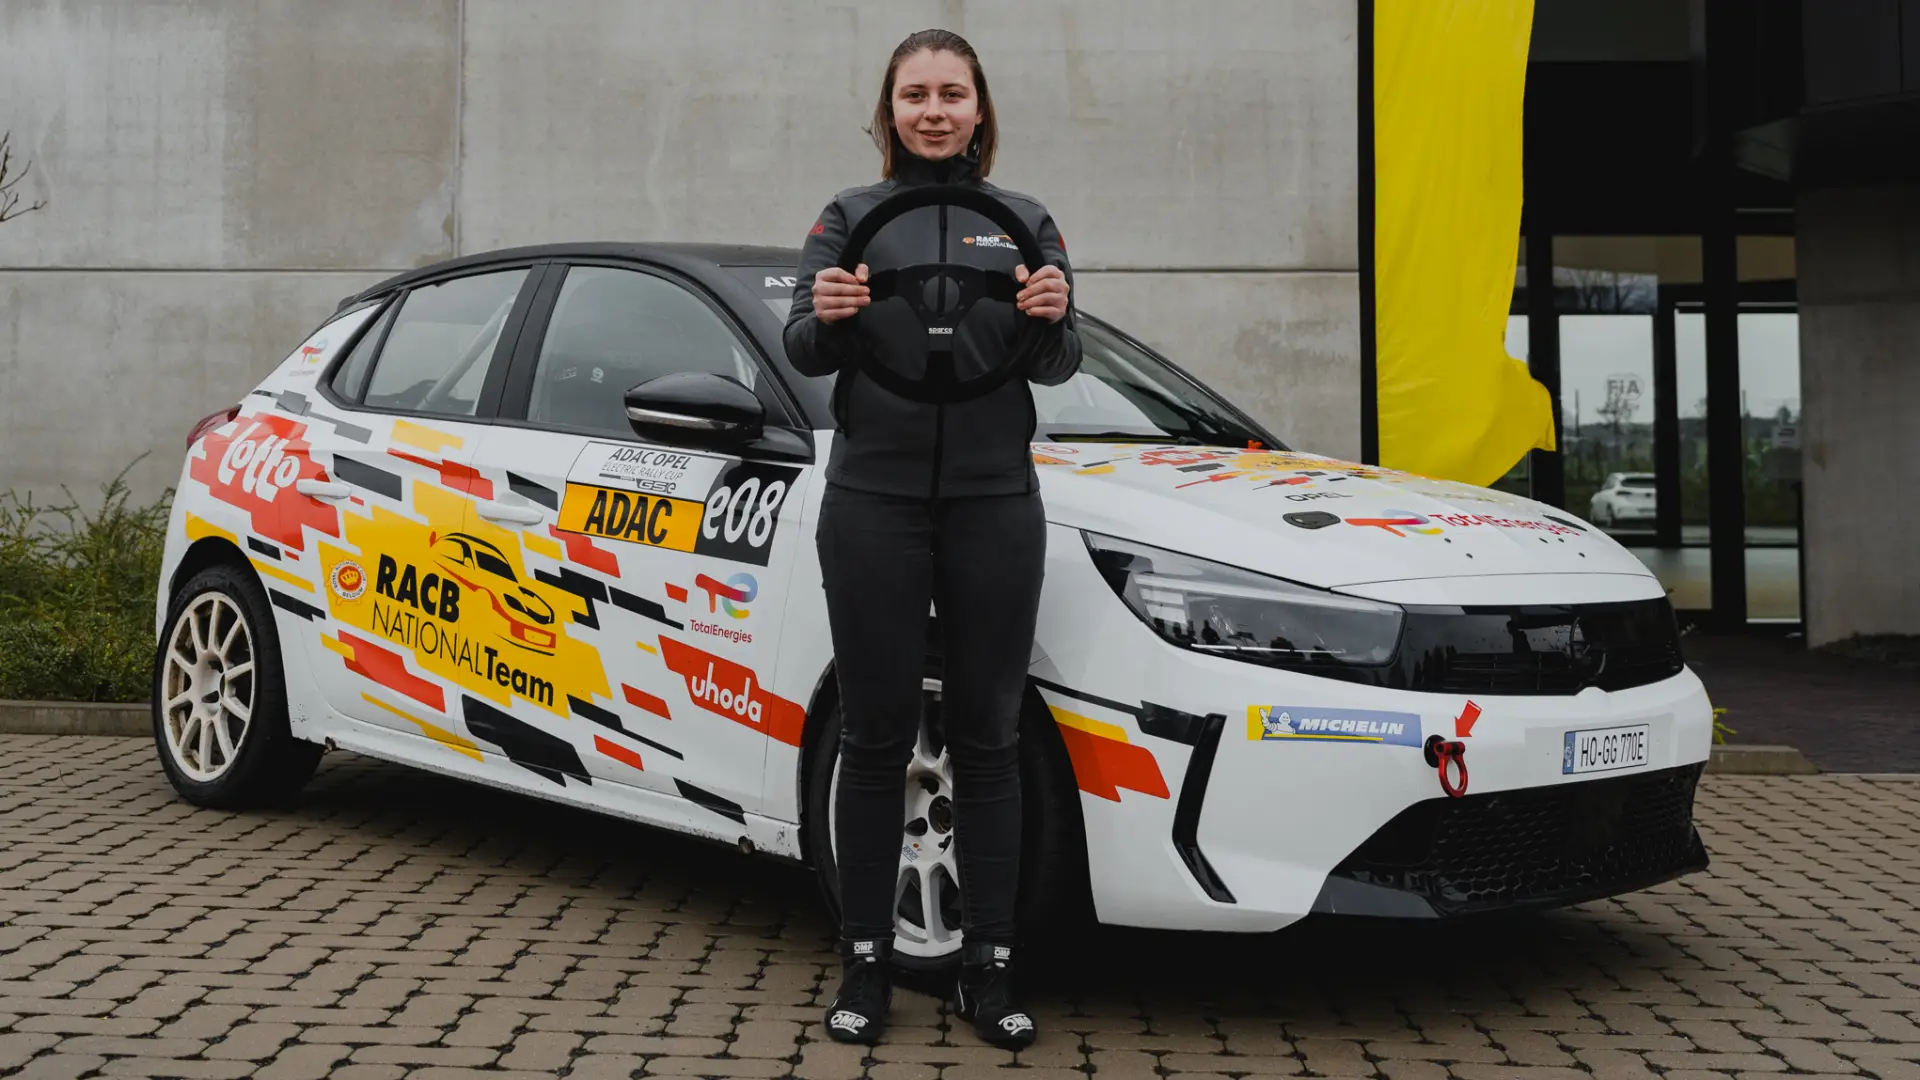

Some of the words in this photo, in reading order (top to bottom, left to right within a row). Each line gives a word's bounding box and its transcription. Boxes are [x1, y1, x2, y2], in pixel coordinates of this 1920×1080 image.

[608, 448, 654, 464] ADAC
[652, 453, 691, 469] OPEL
[601, 462, 639, 475] ELECTRIC
[640, 467, 664, 478] RALLY
[665, 470, 684, 480] CUP
[1284, 492, 1354, 502] OPEL
[583, 489, 673, 545] ADAC
[702, 476, 786, 548] e08
[376, 553, 460, 623] RACB
[690, 619, 753, 643] TotalEnergies
[691, 662, 763, 723] uhoda
[1299, 718, 1404, 735] MICHELIN
[1580, 734, 1618, 767] HO-GG
[1620, 731, 1645, 763] 770E
[853, 943, 874, 952] OMP
[993, 948, 1011, 958] OMP
[830, 1013, 867, 1031] OMP
[1003, 1015, 1033, 1031] OMP
